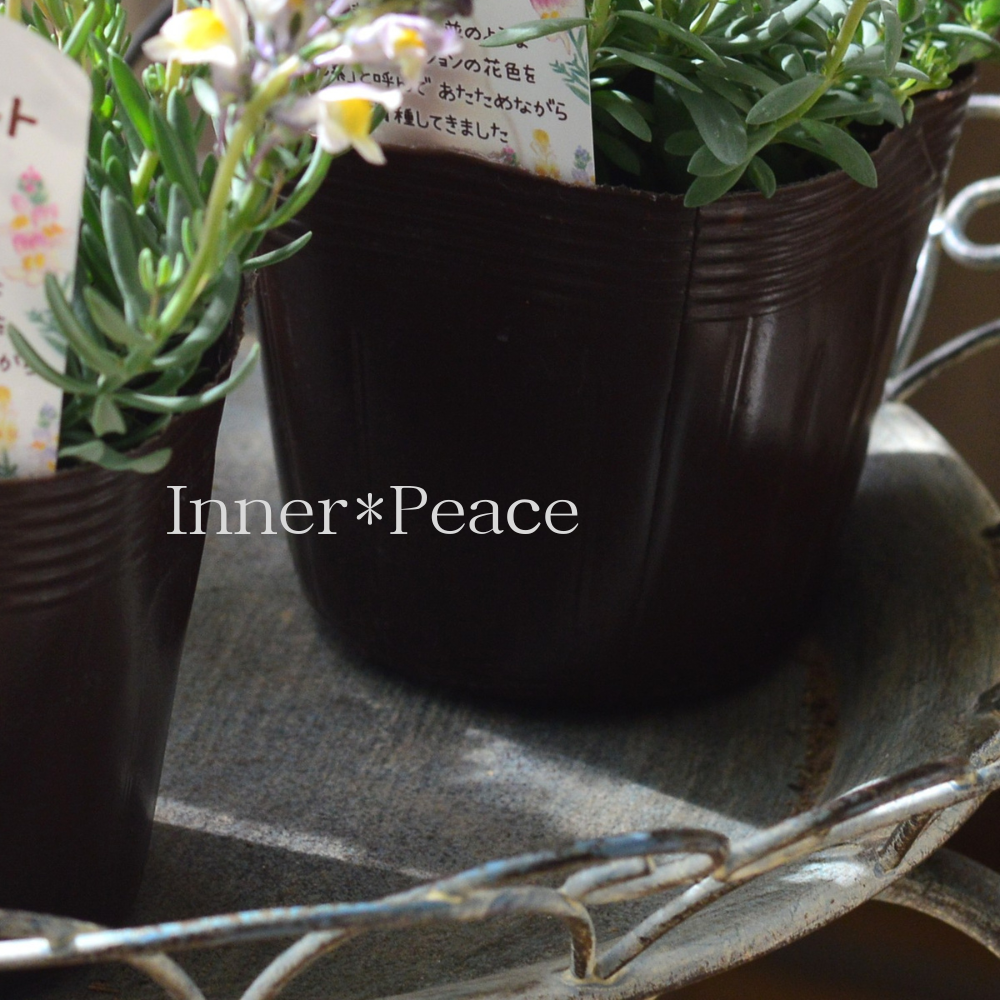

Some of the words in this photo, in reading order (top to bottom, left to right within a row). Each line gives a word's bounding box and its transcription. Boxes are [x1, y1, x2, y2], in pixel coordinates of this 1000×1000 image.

[438, 81, 568, 121] あたためながら
[384, 107, 509, 143] 種してきました
